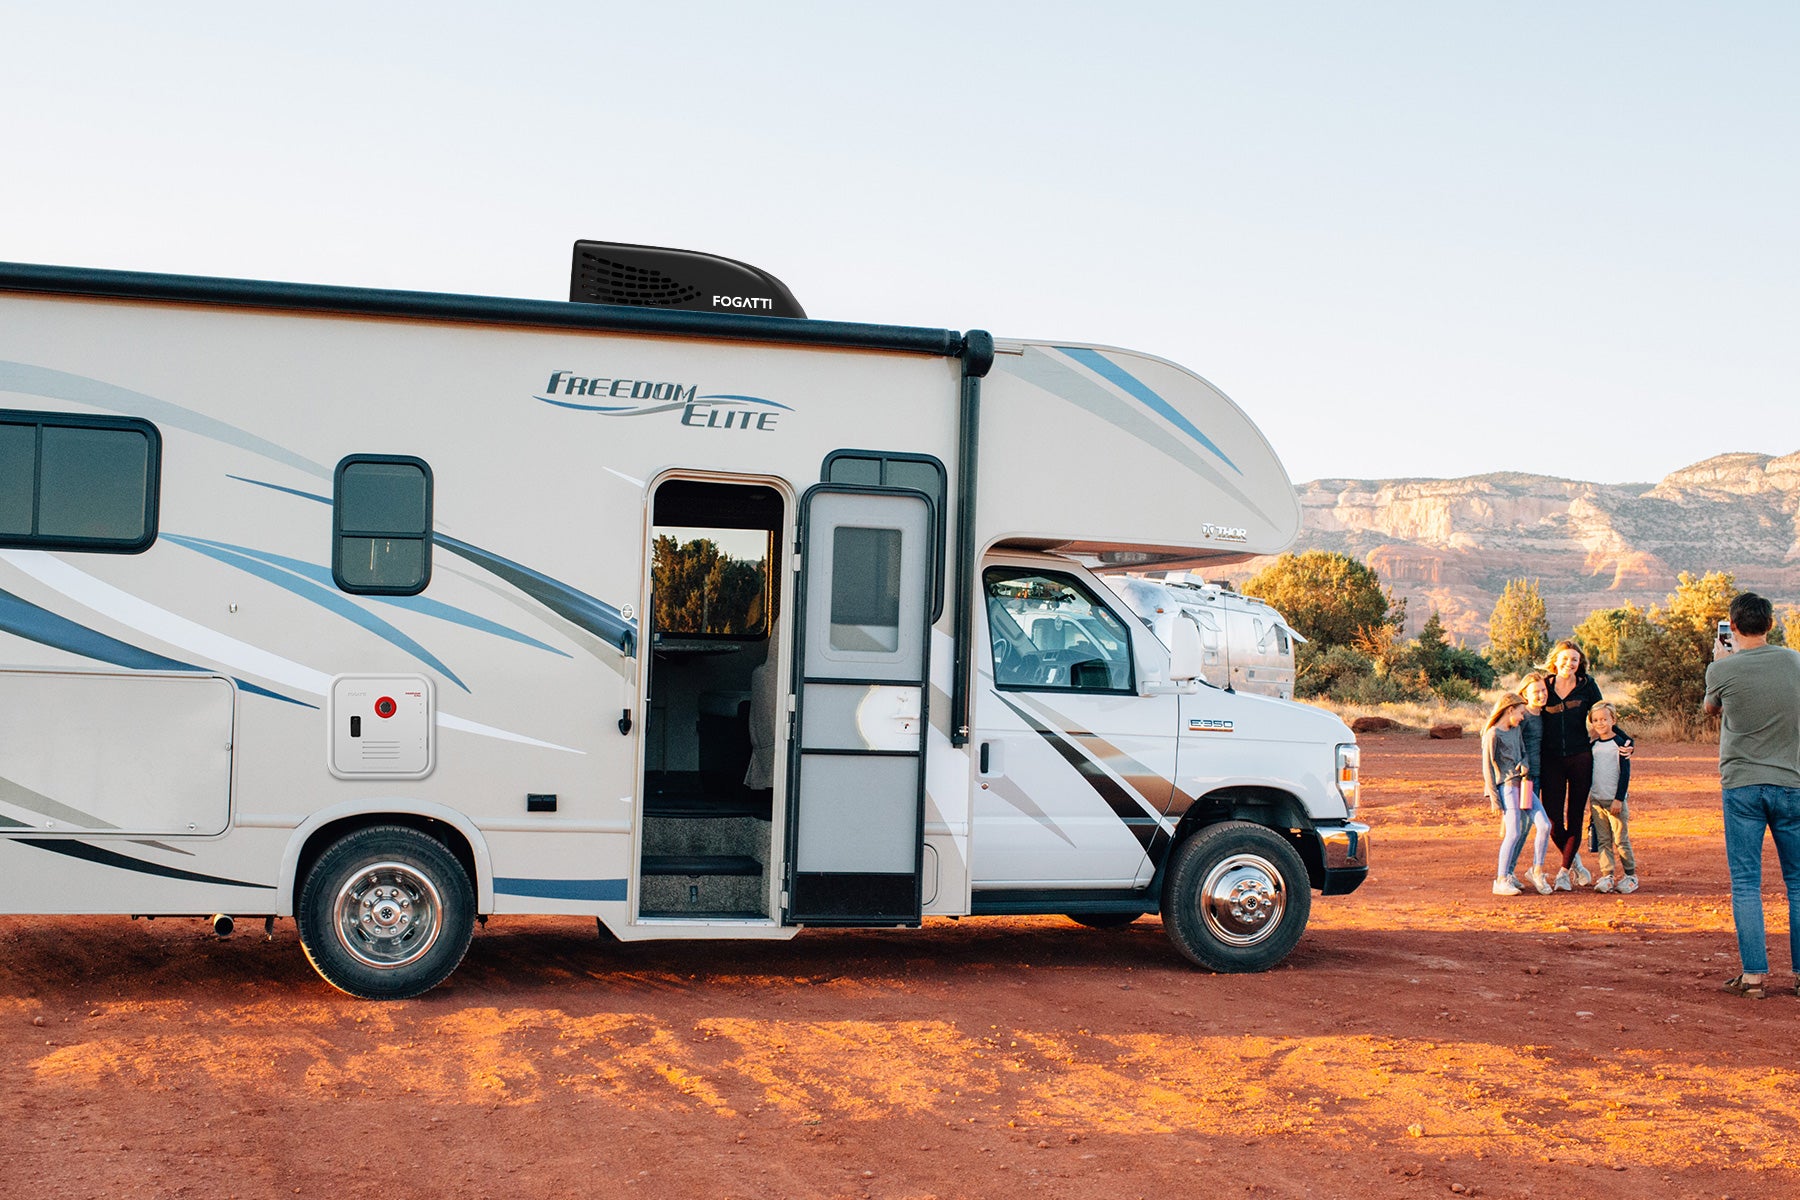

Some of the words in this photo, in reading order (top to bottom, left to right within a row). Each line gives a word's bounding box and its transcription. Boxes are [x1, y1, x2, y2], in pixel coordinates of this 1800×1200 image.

[713, 295, 772, 310] FOGATTI
[546, 369, 698, 402] FREEDOM
[680, 402, 780, 431] ELITE
[1214, 526, 1247, 540] THOR
